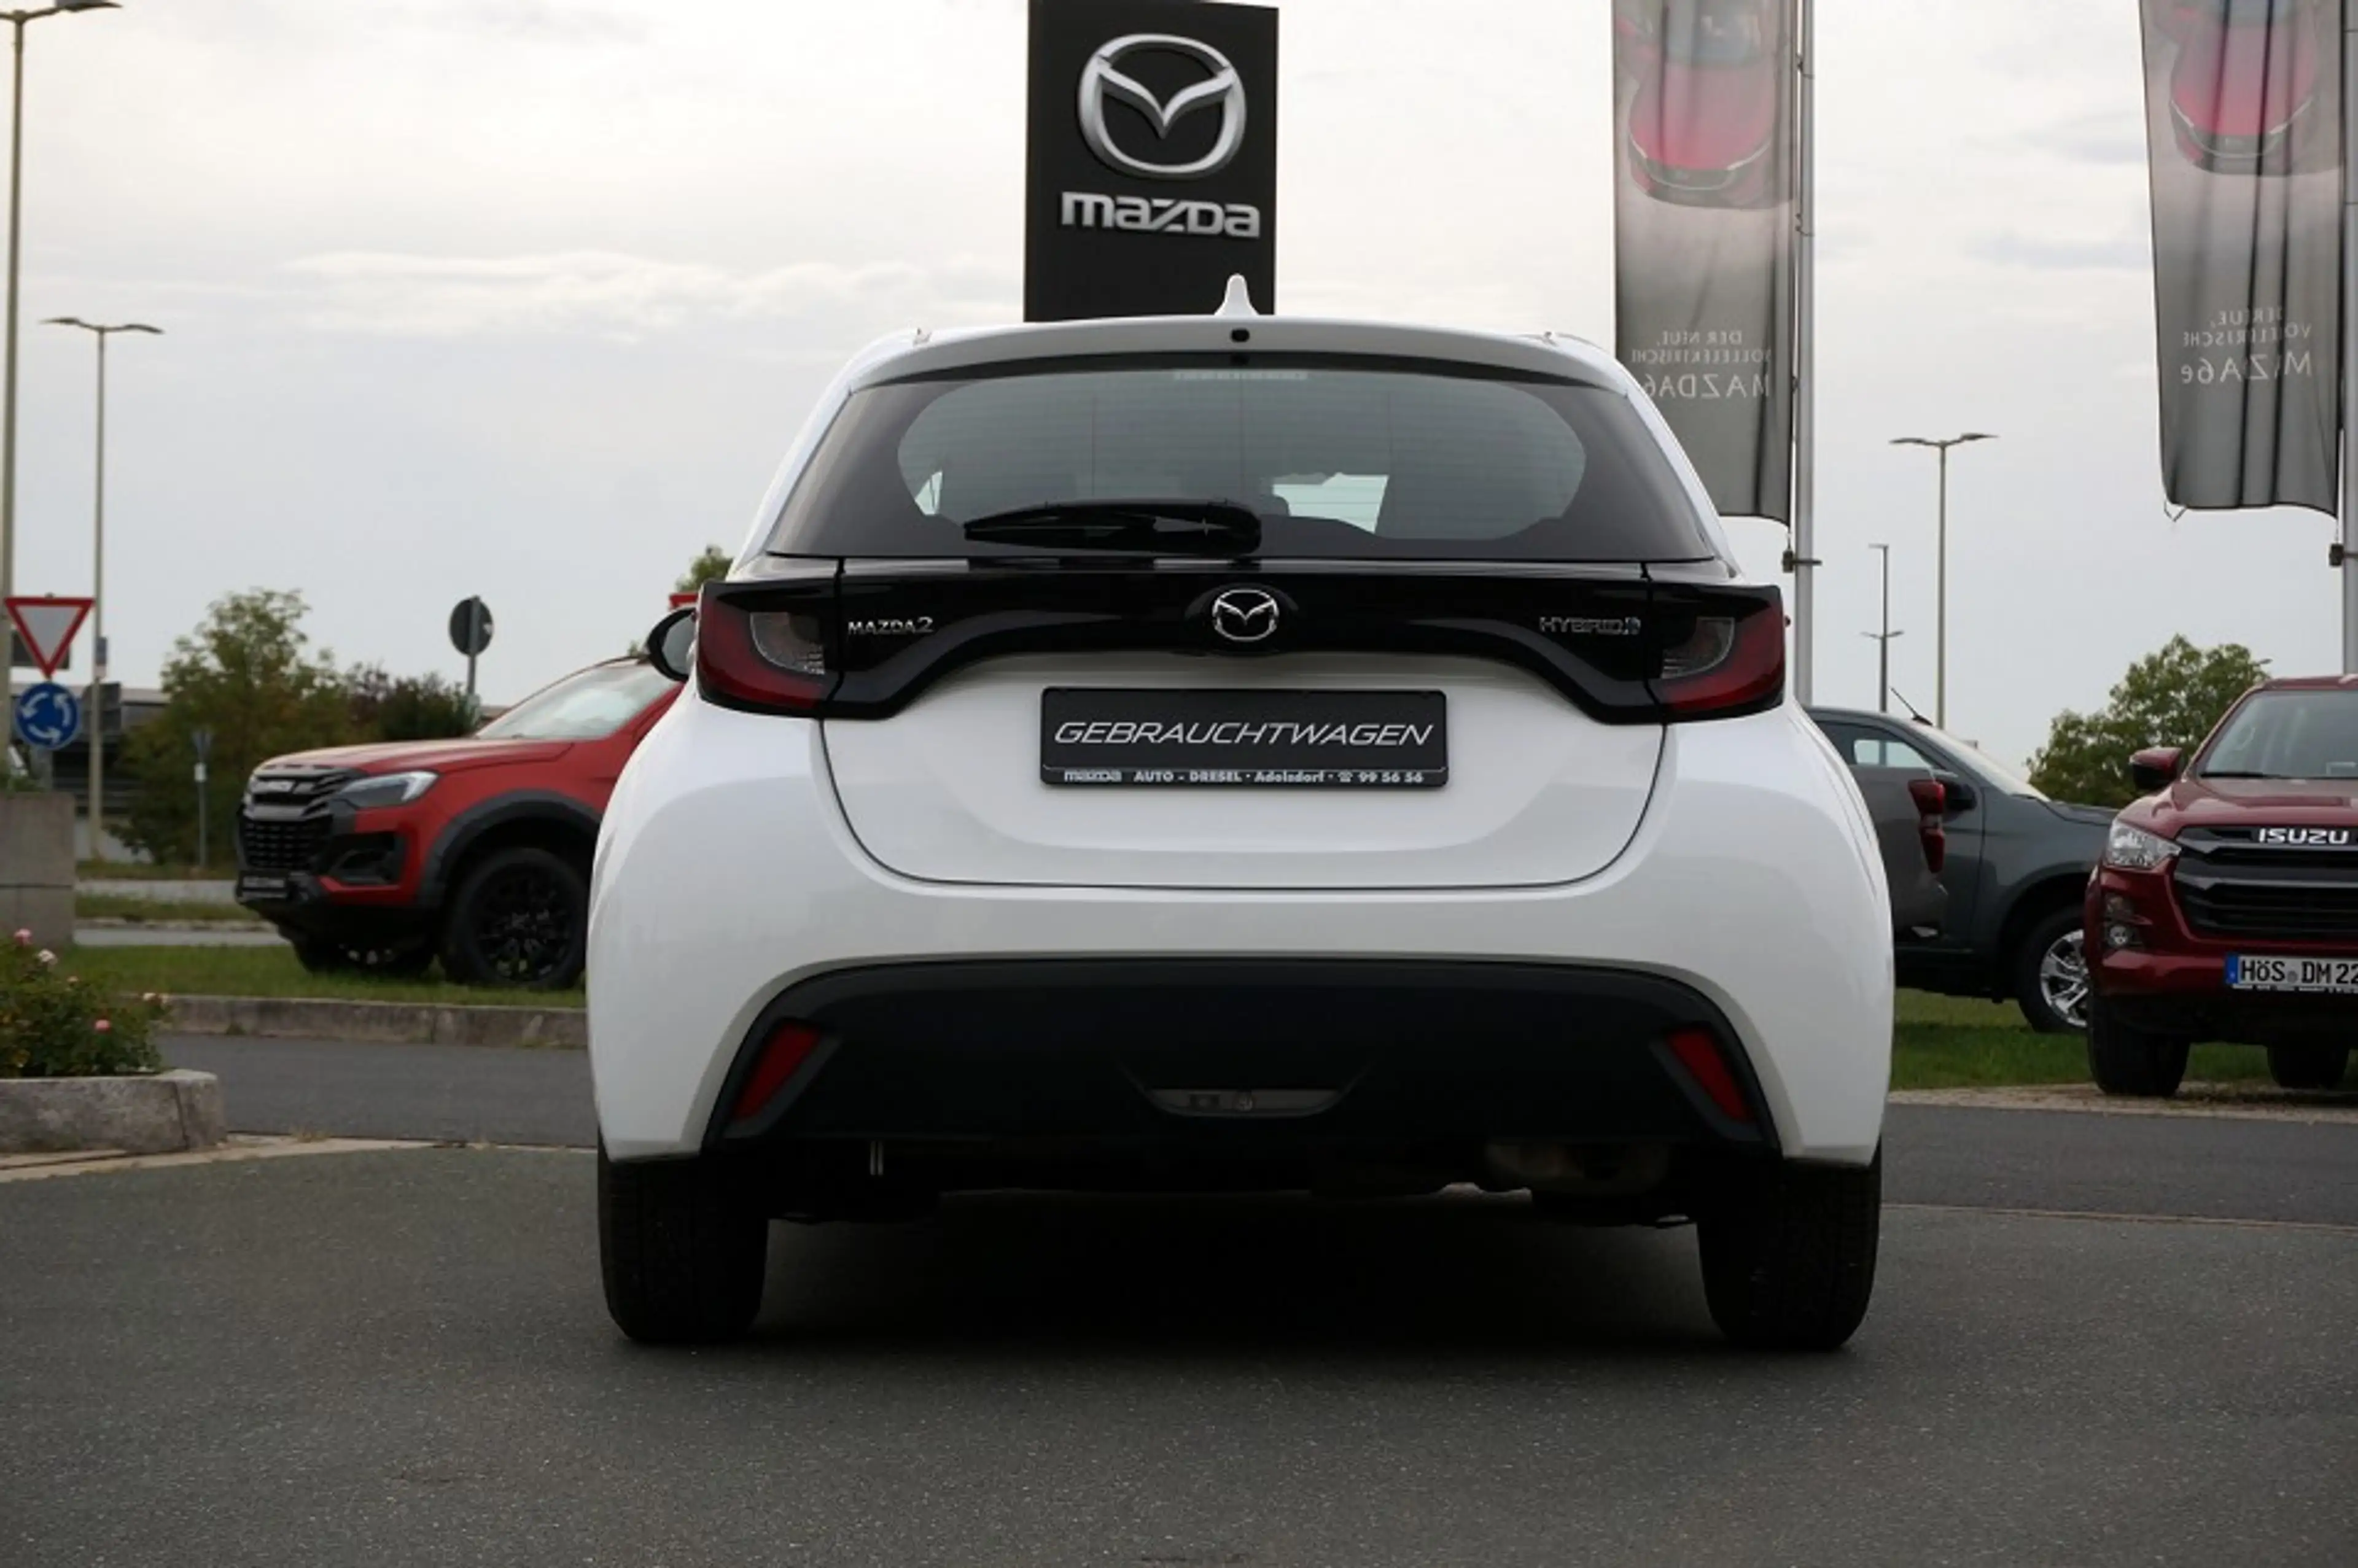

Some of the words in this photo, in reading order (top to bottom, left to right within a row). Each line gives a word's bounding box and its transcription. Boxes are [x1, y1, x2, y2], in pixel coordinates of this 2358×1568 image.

[1062, 191, 1260, 238] mazda
[848, 616, 933, 635] MAZDA2
[1054, 721, 1434, 746] GEBRAUCHTWAGEN
[1134, 770, 1173, 782] AUTO
[1189, 770, 1243, 783] DRESEL
[2259, 828, 2349, 845] ISUZU
[2302, 961, 2332, 984] DM
